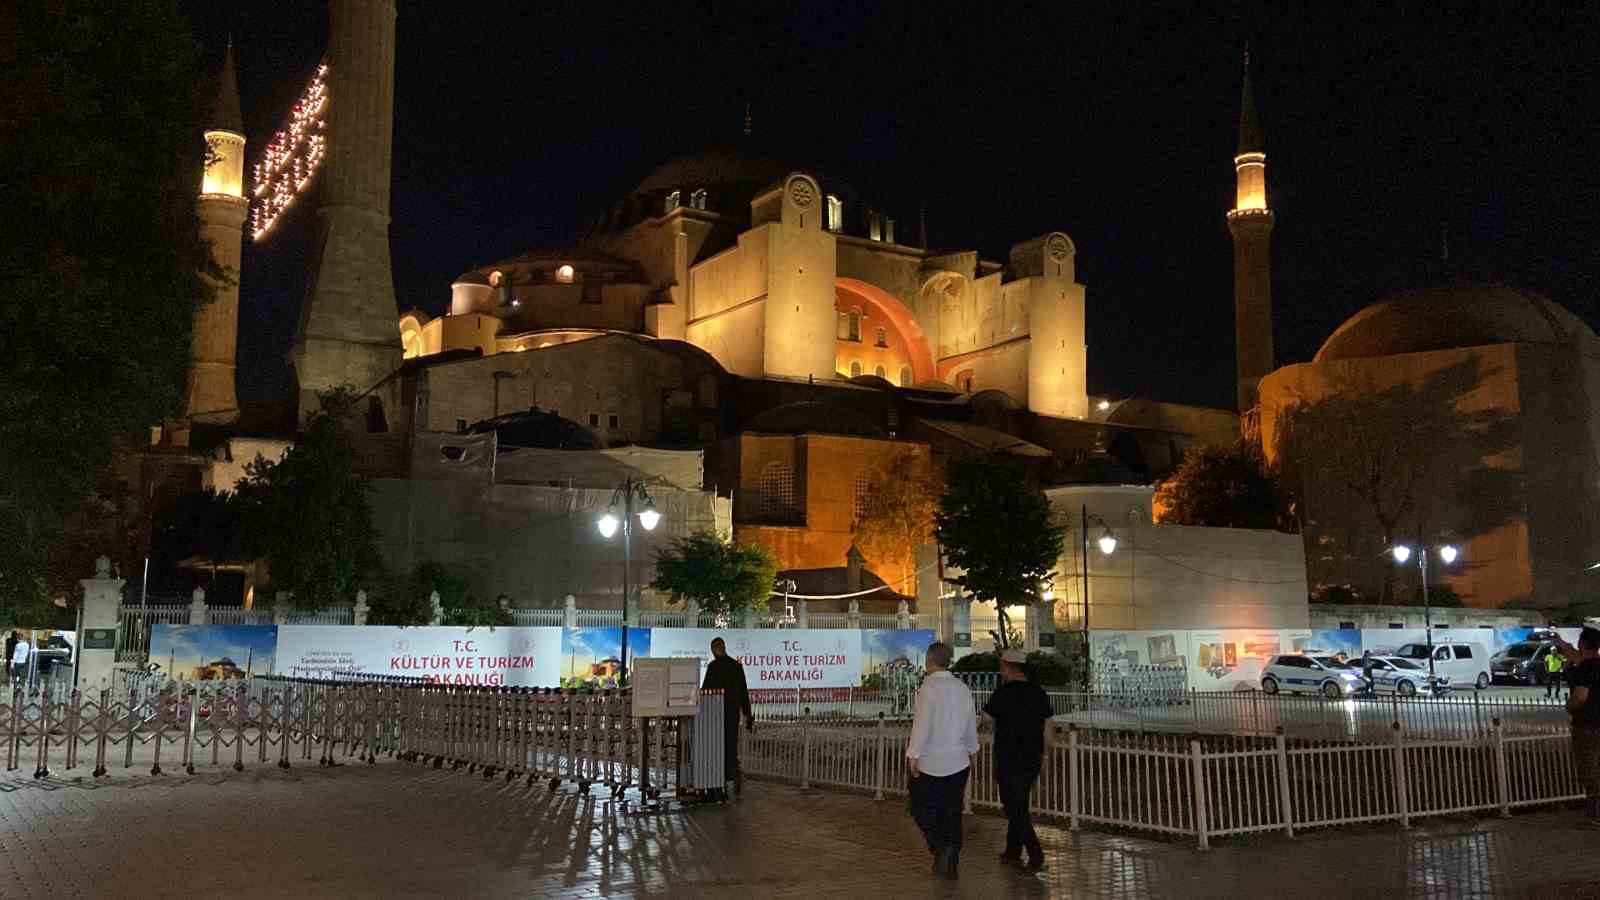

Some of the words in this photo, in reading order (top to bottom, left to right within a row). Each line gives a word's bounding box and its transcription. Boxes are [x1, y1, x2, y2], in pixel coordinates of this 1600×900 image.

[454, 640, 478, 653] T.C.
[783, 640, 803, 652] T.C.
[391, 654, 450, 669] KÜLTÜR
[455, 657, 473, 669] VE
[478, 655, 534, 669] TURİZM
[786, 655, 800, 665] VE
[804, 653, 846, 665] TURİZM
[760, 668, 822, 681] BAKANLIĞI
